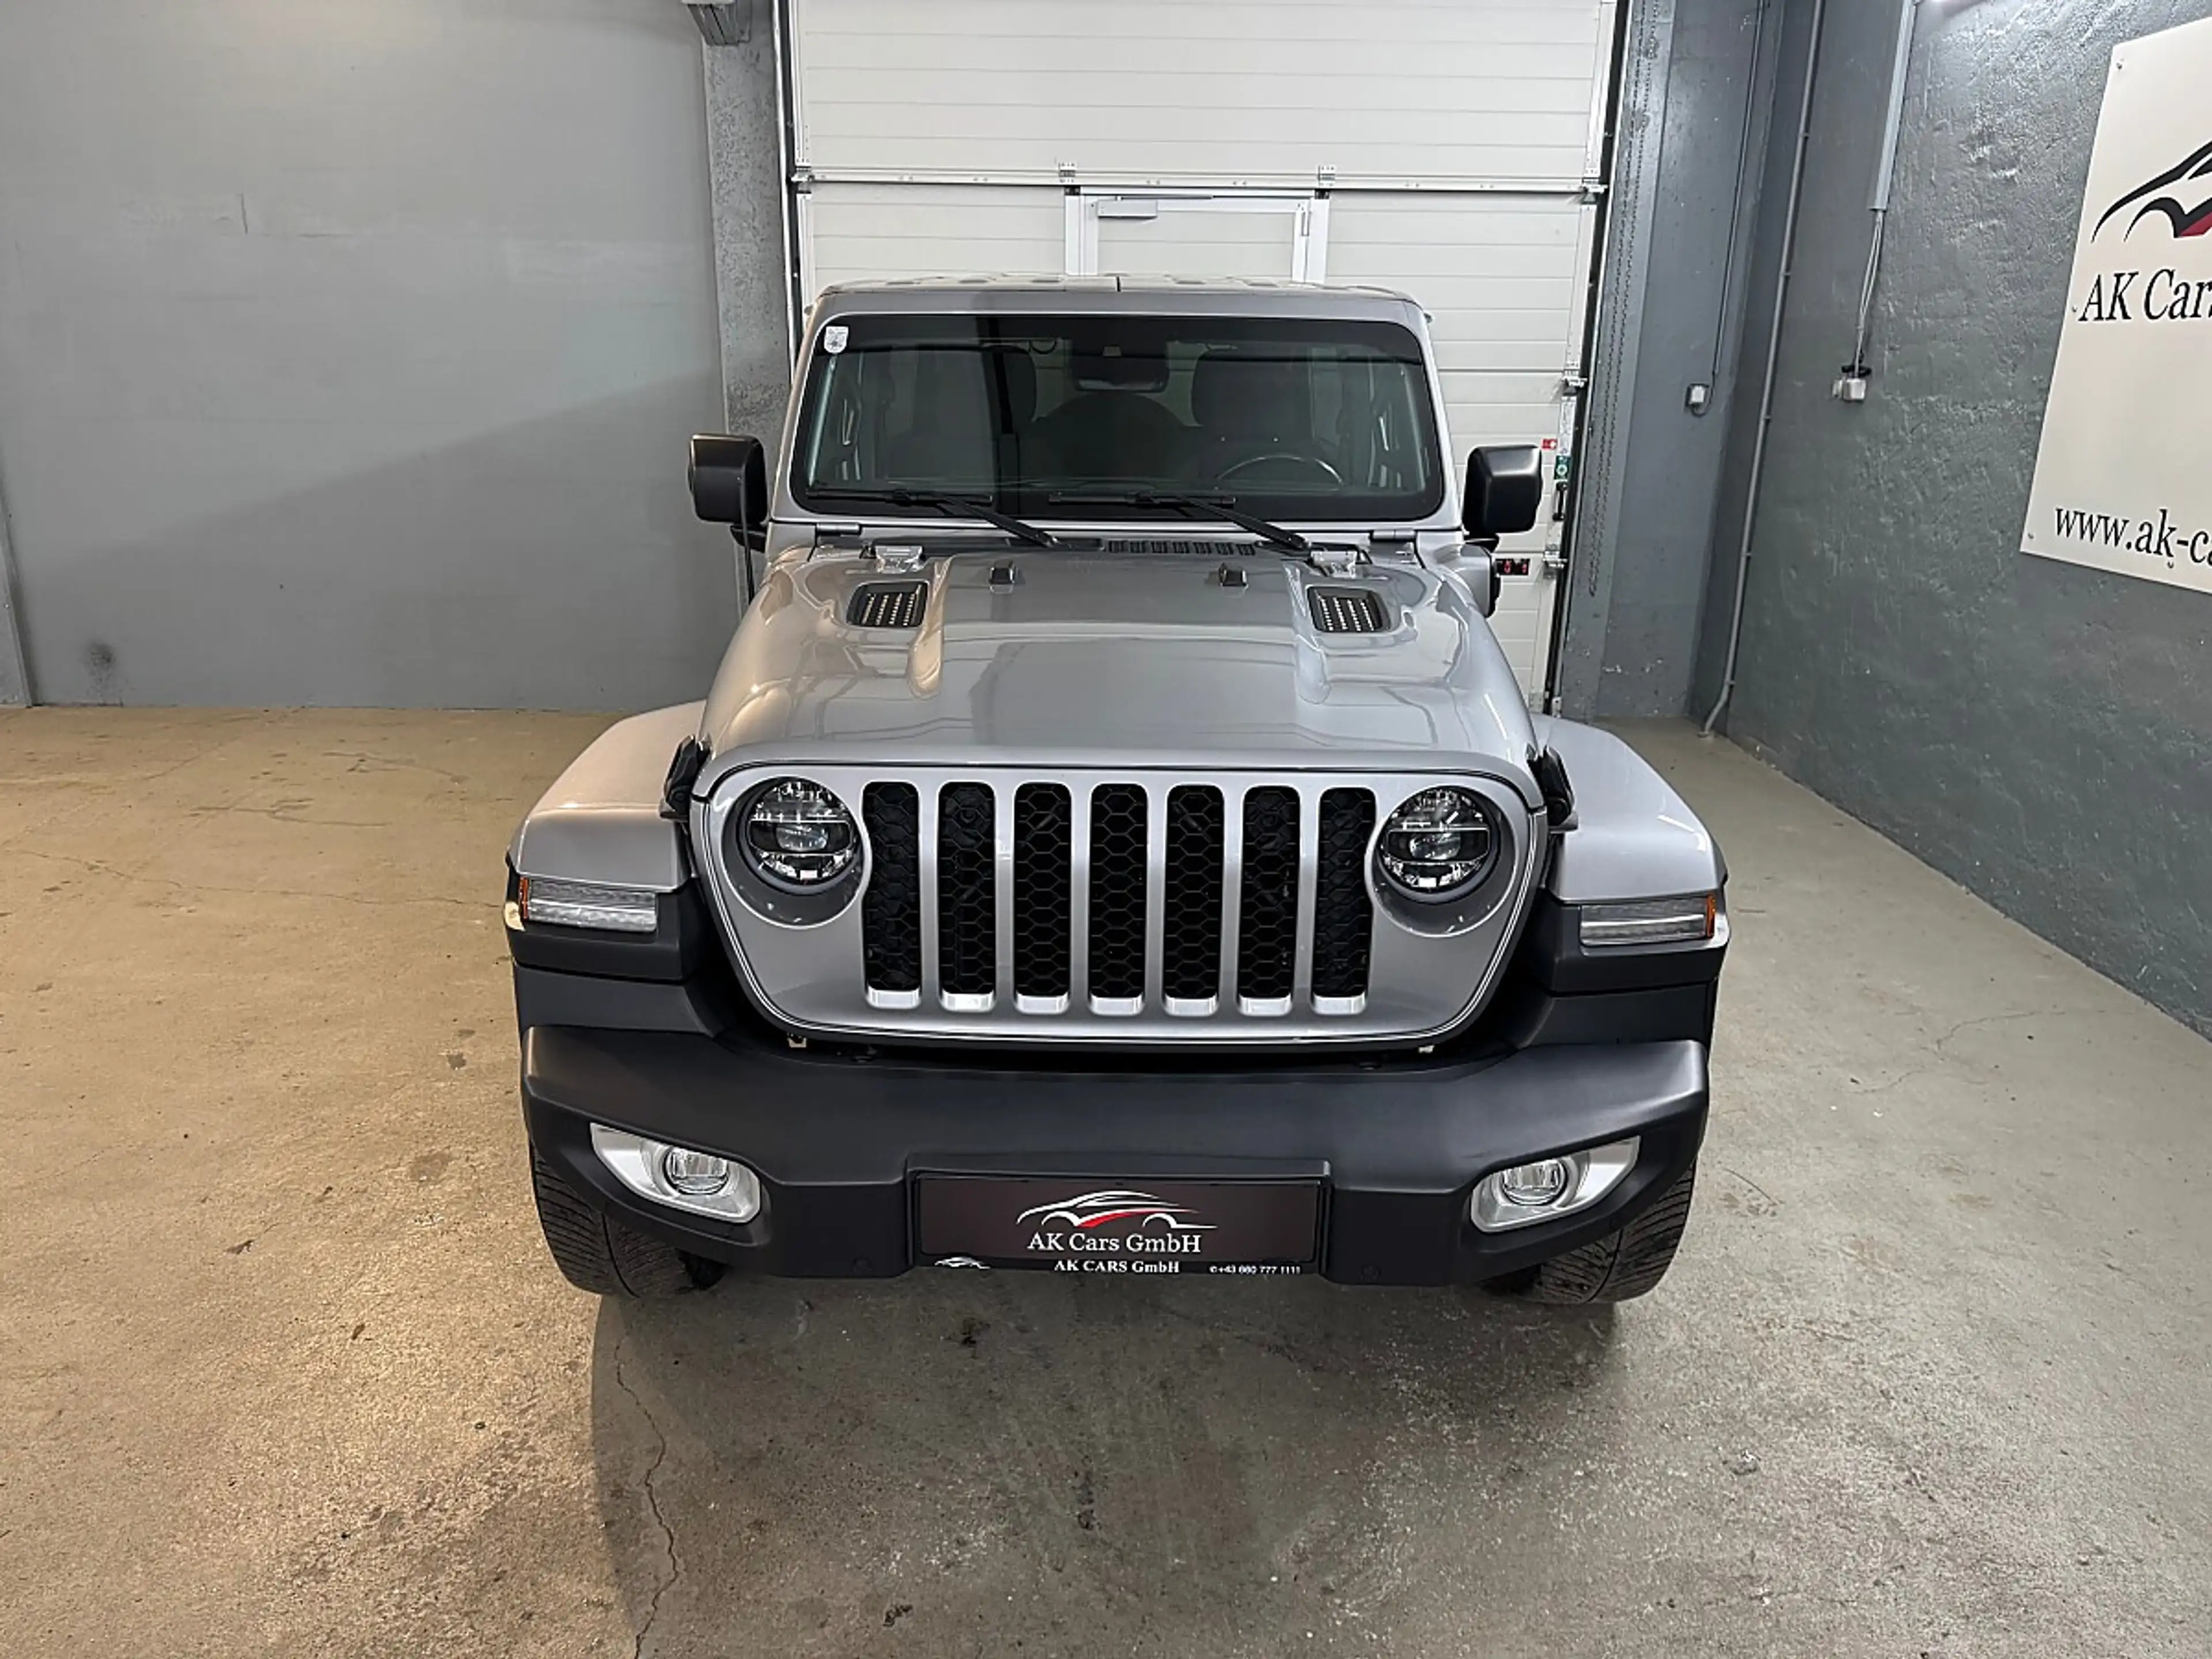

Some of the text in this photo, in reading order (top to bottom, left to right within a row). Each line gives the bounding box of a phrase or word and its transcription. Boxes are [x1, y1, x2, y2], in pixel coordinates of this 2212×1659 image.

[2078, 271, 2139, 321] AK
[1027, 1232, 1202, 1253] AK Cars GmbH
[1054, 1259, 1180, 1273] AK CARS GmbH
